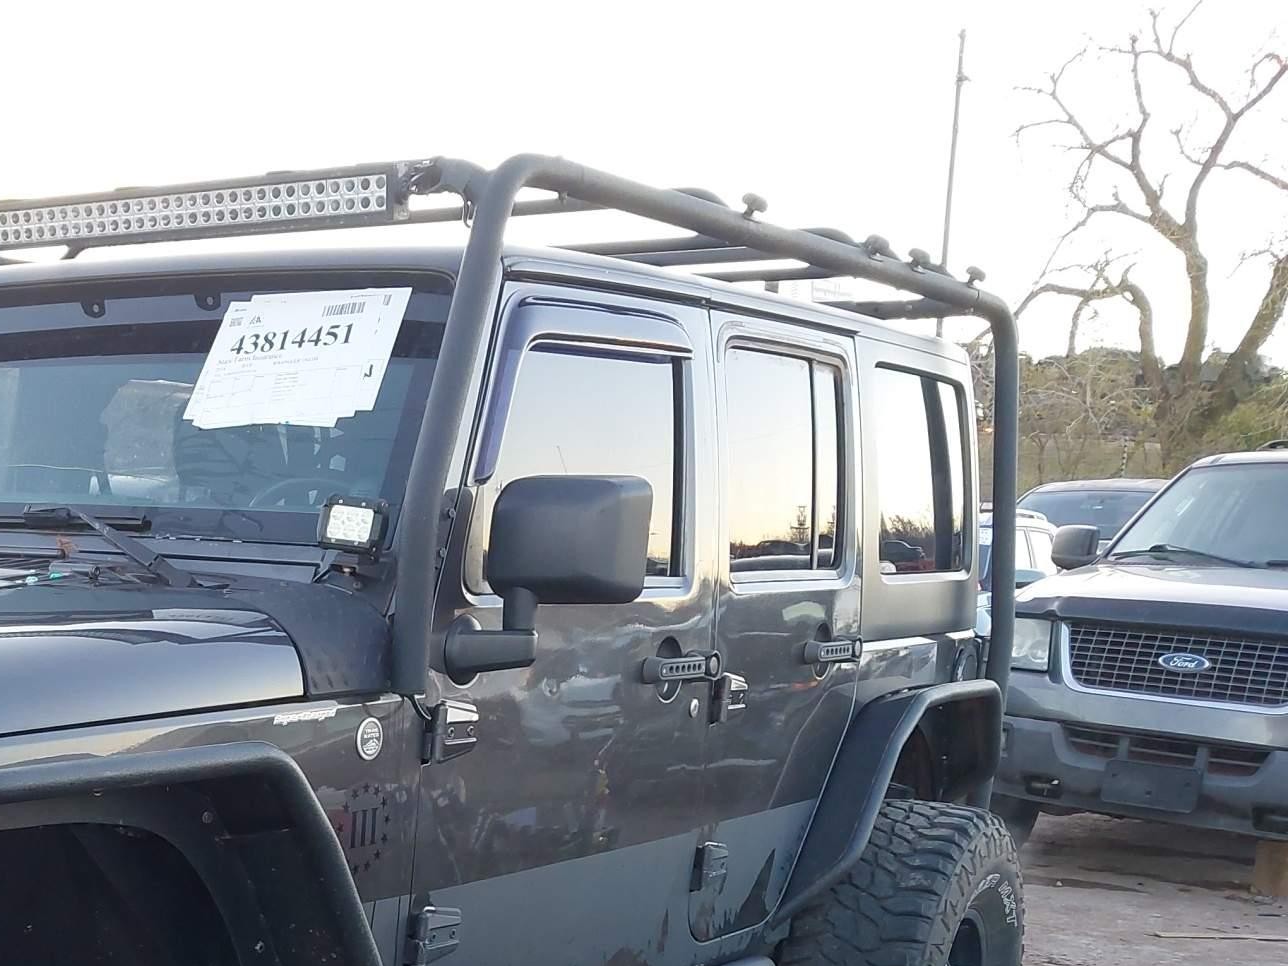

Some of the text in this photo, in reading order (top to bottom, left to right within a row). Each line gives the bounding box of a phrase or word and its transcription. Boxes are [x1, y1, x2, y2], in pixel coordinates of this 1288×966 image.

[230, 323, 354, 355] 43814451
[1169, 656, 1199, 669] Ford
[998, 880, 1018, 928] MXT
